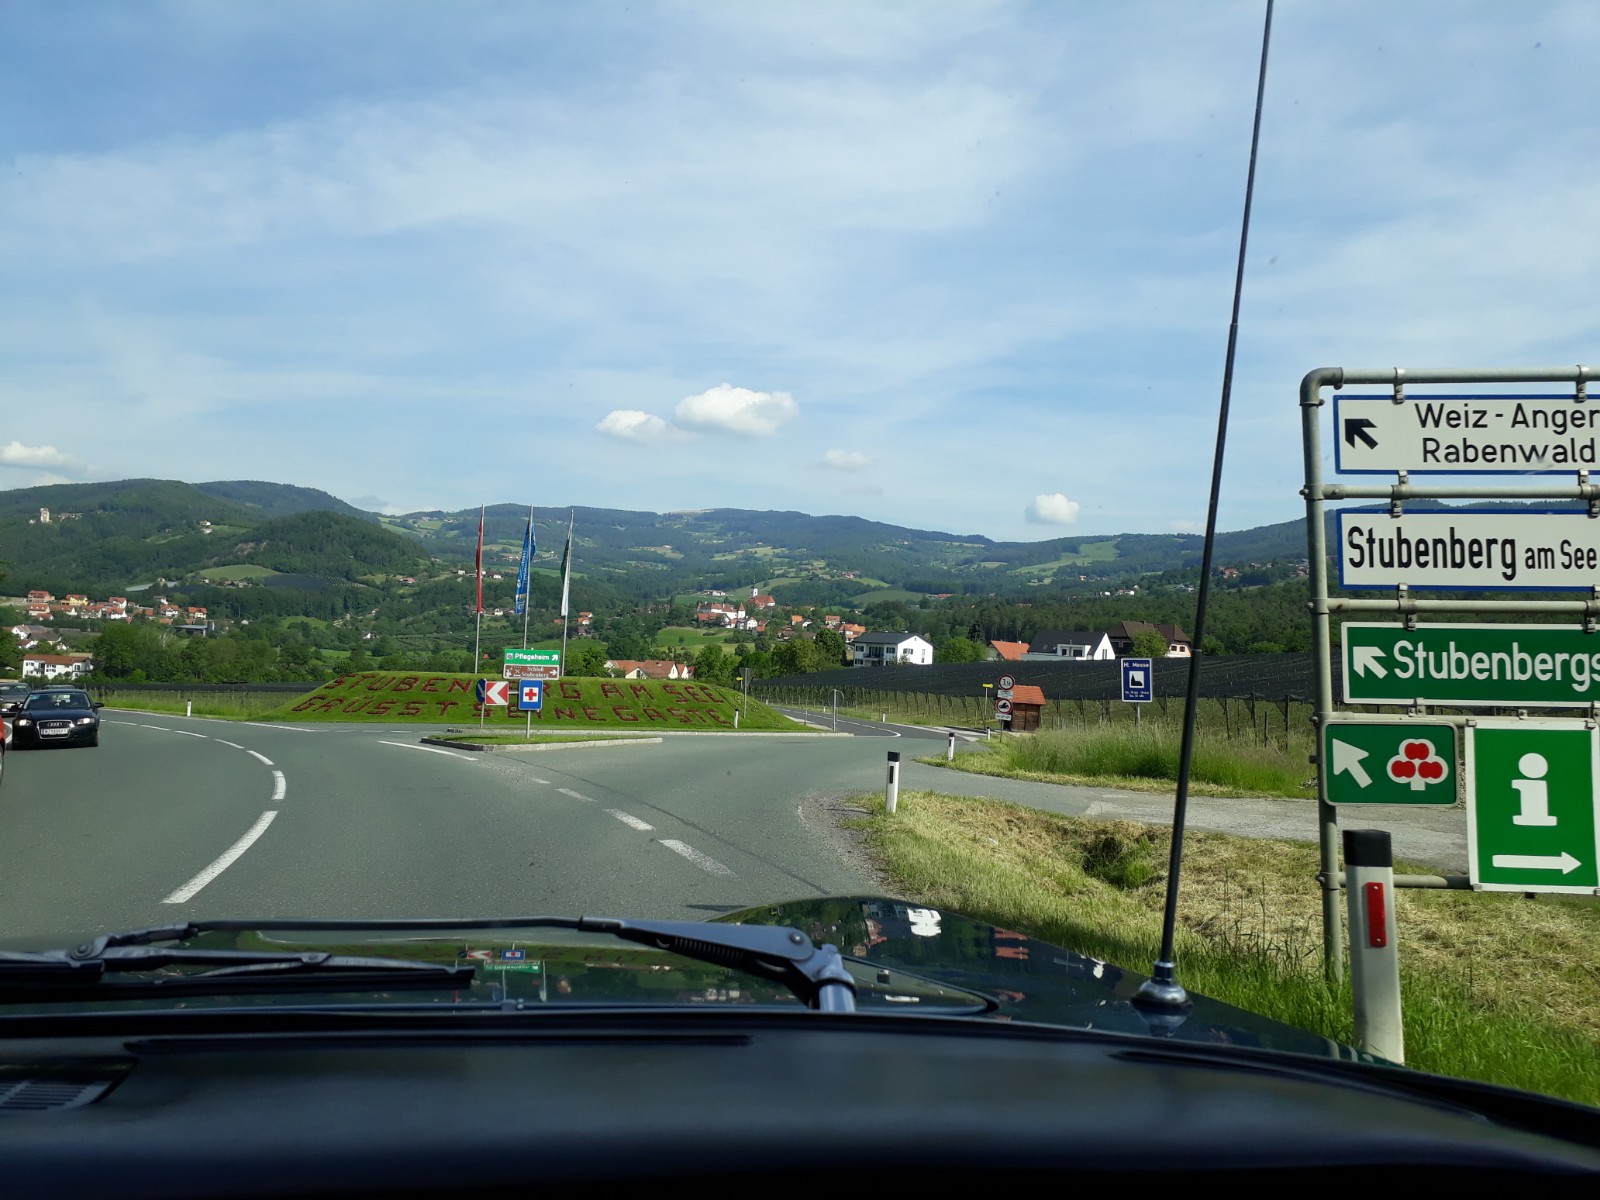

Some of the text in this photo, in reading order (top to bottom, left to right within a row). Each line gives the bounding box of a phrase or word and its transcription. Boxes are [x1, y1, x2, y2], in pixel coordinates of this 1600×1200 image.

[1414, 402, 1488, 429] Weiz
[1510, 402, 1600, 435] Anger
[1422, 437, 1596, 463] Rabenwald
[1347, 525, 1598, 581] Stubenberg am See
[515, 653, 549, 661] Pflegeheim
[602, 683, 655, 701] AM
[662, 684, 724, 704] SEE
